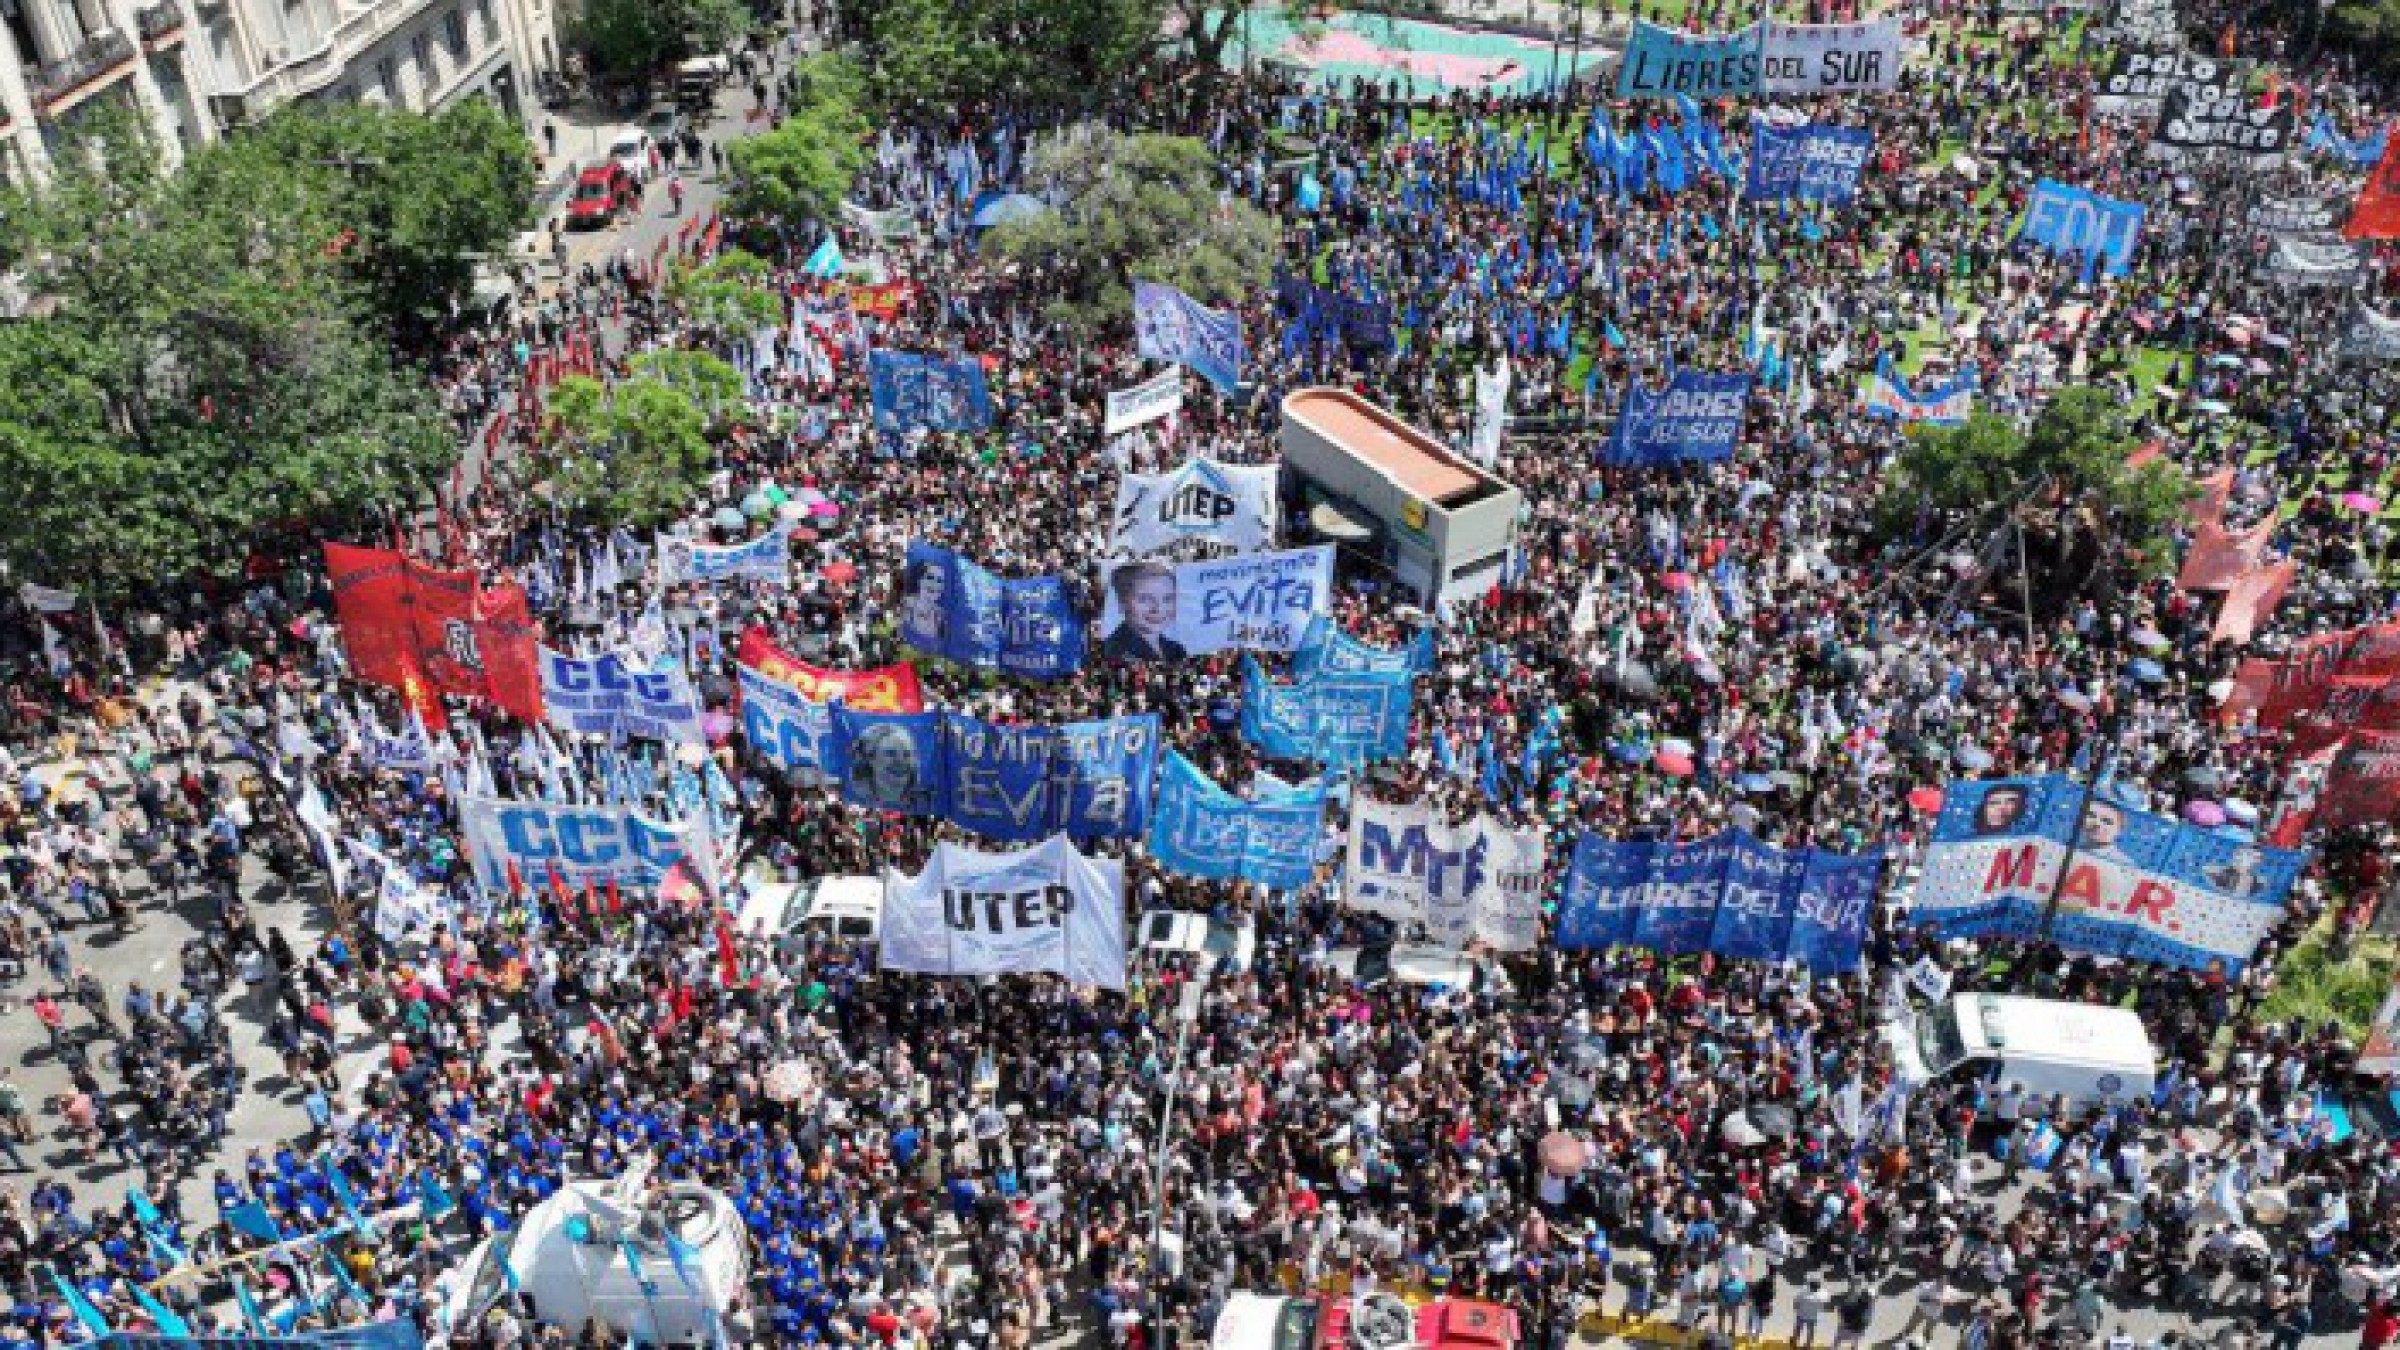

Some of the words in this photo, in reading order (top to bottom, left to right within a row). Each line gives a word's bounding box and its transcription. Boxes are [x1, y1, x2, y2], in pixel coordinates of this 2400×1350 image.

[1633, 50, 1757, 90] LIBRES
[1765, 56, 1807, 79] DEL
[1821, 49, 1883, 85] SUR
[2127, 54, 2217, 82] POLO
[1159, 485, 1235, 523] UTEP
[499, 808, 685, 869] CCC
[942, 882, 1075, 935] UTEP
[1795, 891, 1867, 931] SUR
